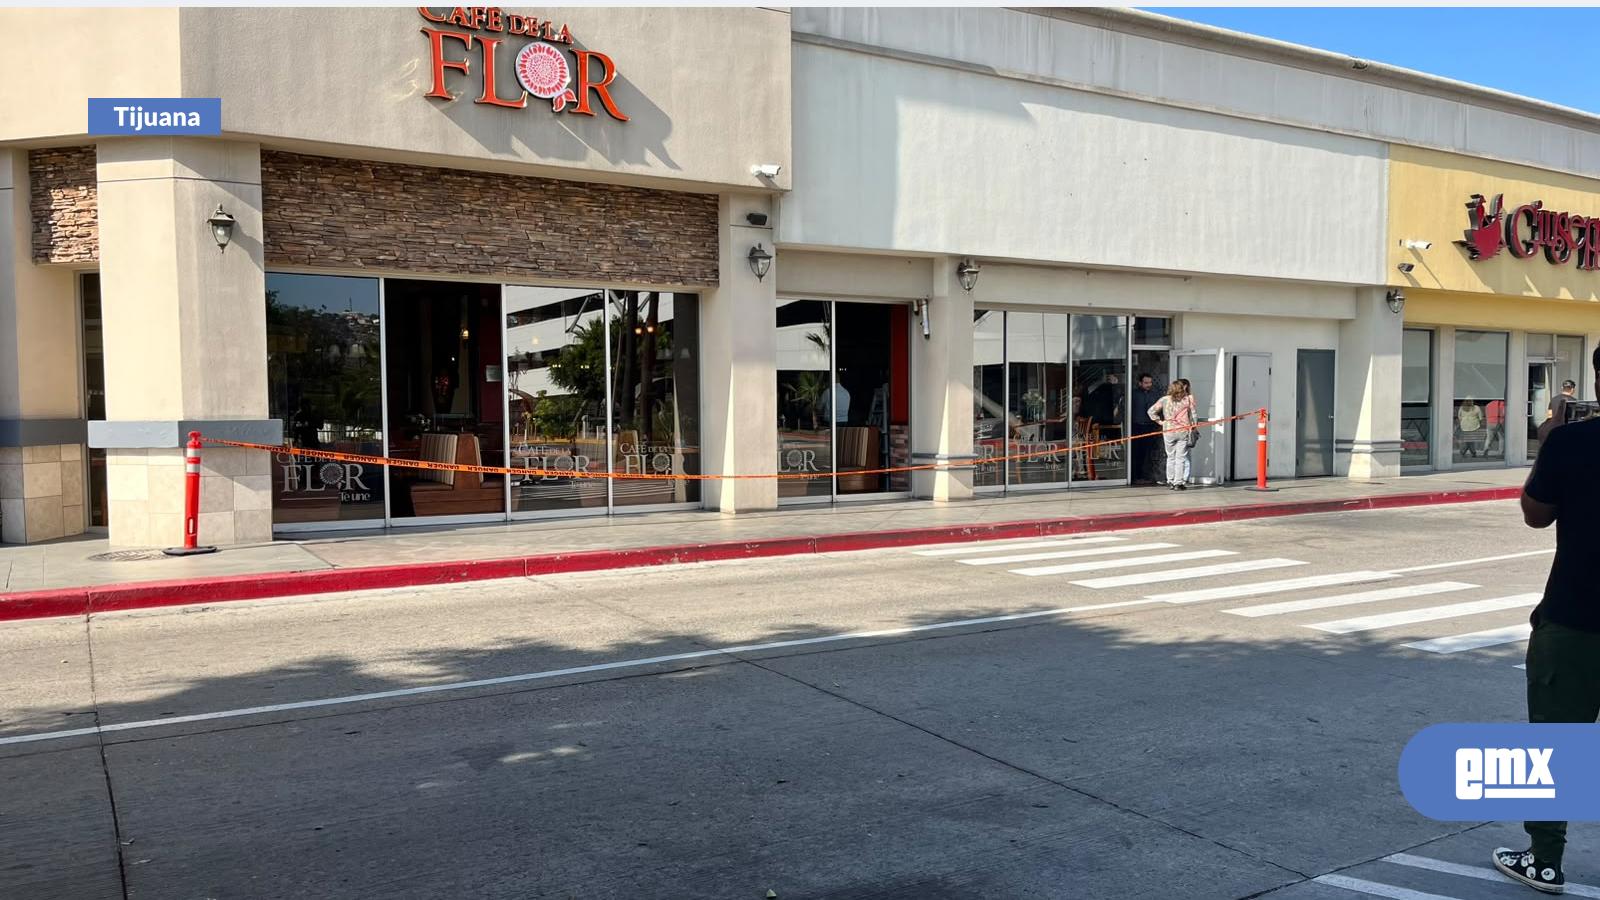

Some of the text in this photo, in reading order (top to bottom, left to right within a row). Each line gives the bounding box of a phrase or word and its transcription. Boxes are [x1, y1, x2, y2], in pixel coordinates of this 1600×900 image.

[507, 14, 540, 37] DE
[543, 20, 574, 44] LA
[420, 26, 631, 121] FLOR
[300, 449, 335, 459] DANGER
[343, 454, 378, 463] DANGER
[386, 458, 419, 467] DANGER
[777, 449, 820, 473] LOR
[281, 462, 370, 493] FLOR
[427, 463, 460, 471] DANGER
[521, 455, 590, 481] FLOR
